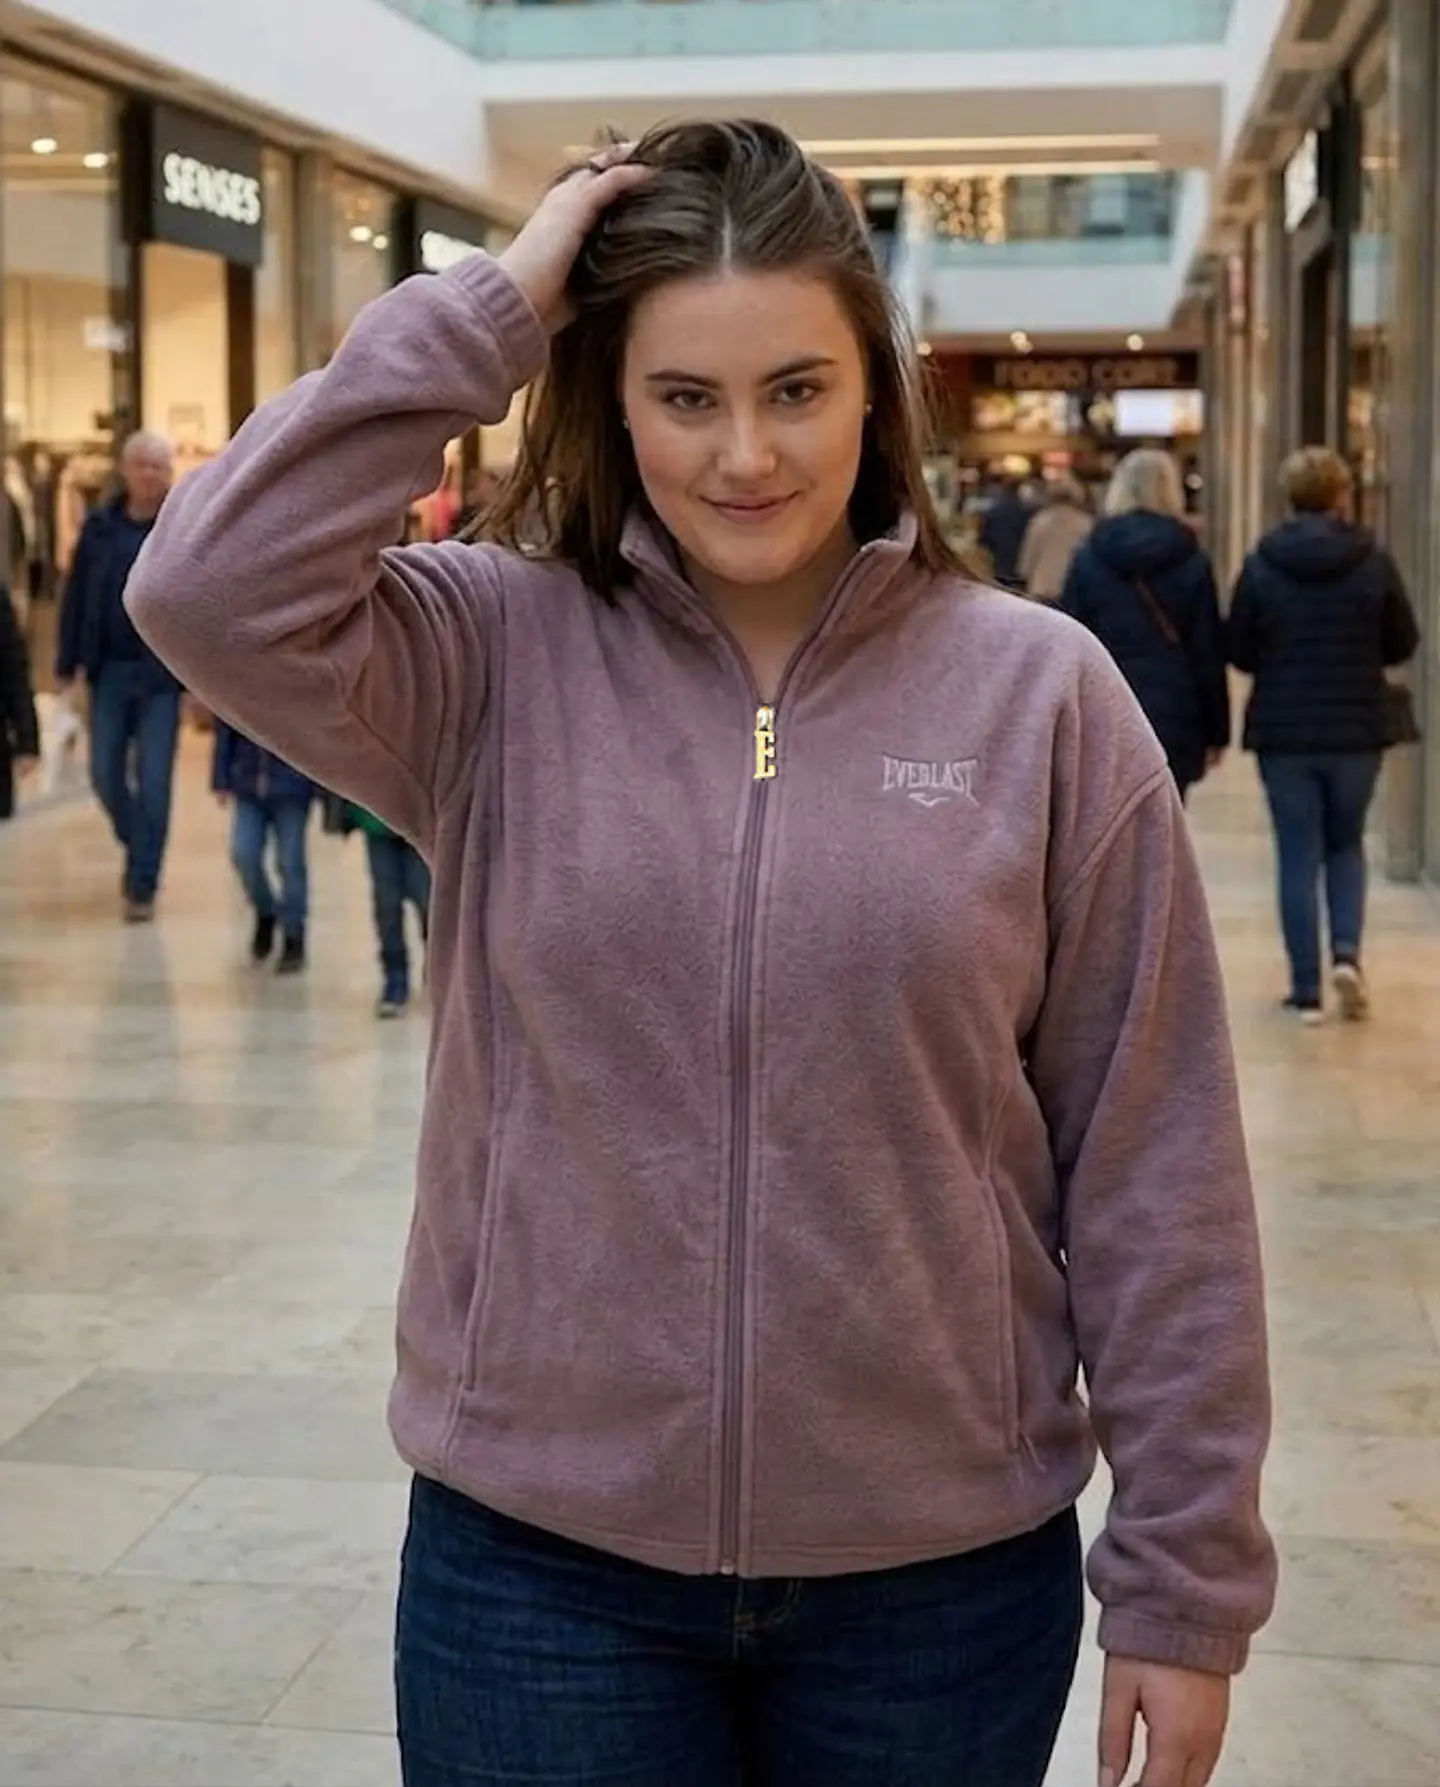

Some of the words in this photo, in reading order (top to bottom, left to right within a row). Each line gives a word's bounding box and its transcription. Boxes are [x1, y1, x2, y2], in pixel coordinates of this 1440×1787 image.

[163, 152, 261, 225] SENSES
[753, 730, 777, 779] E
[882, 755, 980, 806] EVERLAST
